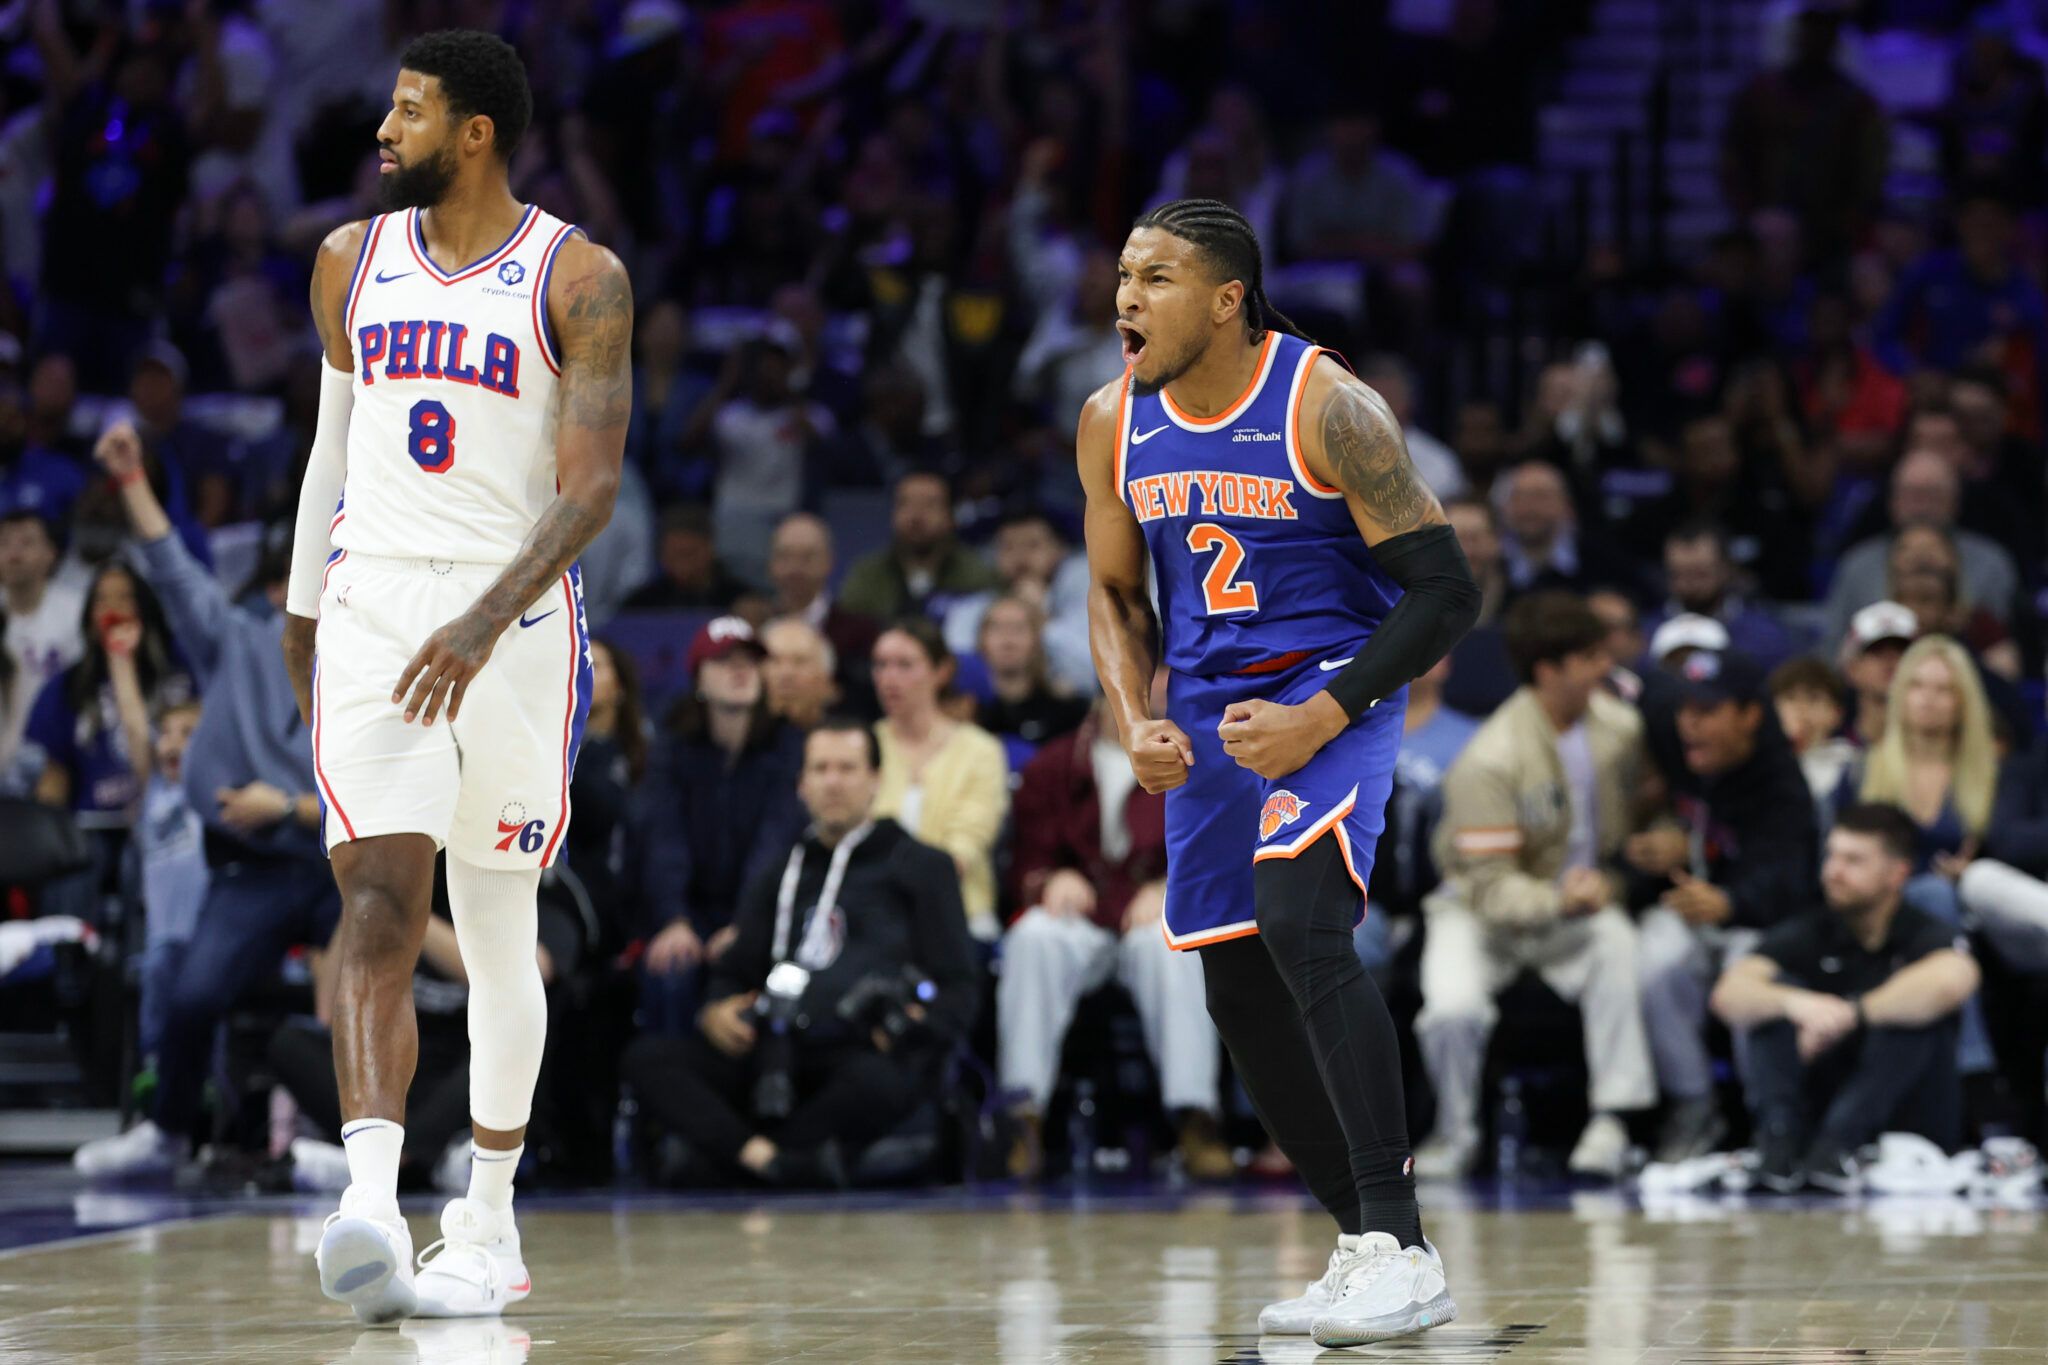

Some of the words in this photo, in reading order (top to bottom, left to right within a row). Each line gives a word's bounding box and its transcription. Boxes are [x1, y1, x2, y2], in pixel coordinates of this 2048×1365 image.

[481, 286, 531, 300] crypto.com
[358, 320, 520, 399] PHILA
[408, 399, 456, 474] 8
[1232, 433, 1251, 442] abu
[1252, 432, 1281, 441] dhabi
[1127, 471, 1194, 524] NEW
[1196, 471, 1299, 520] YORK
[1186, 523, 1259, 615] 2
[494, 818, 545, 853] 76
